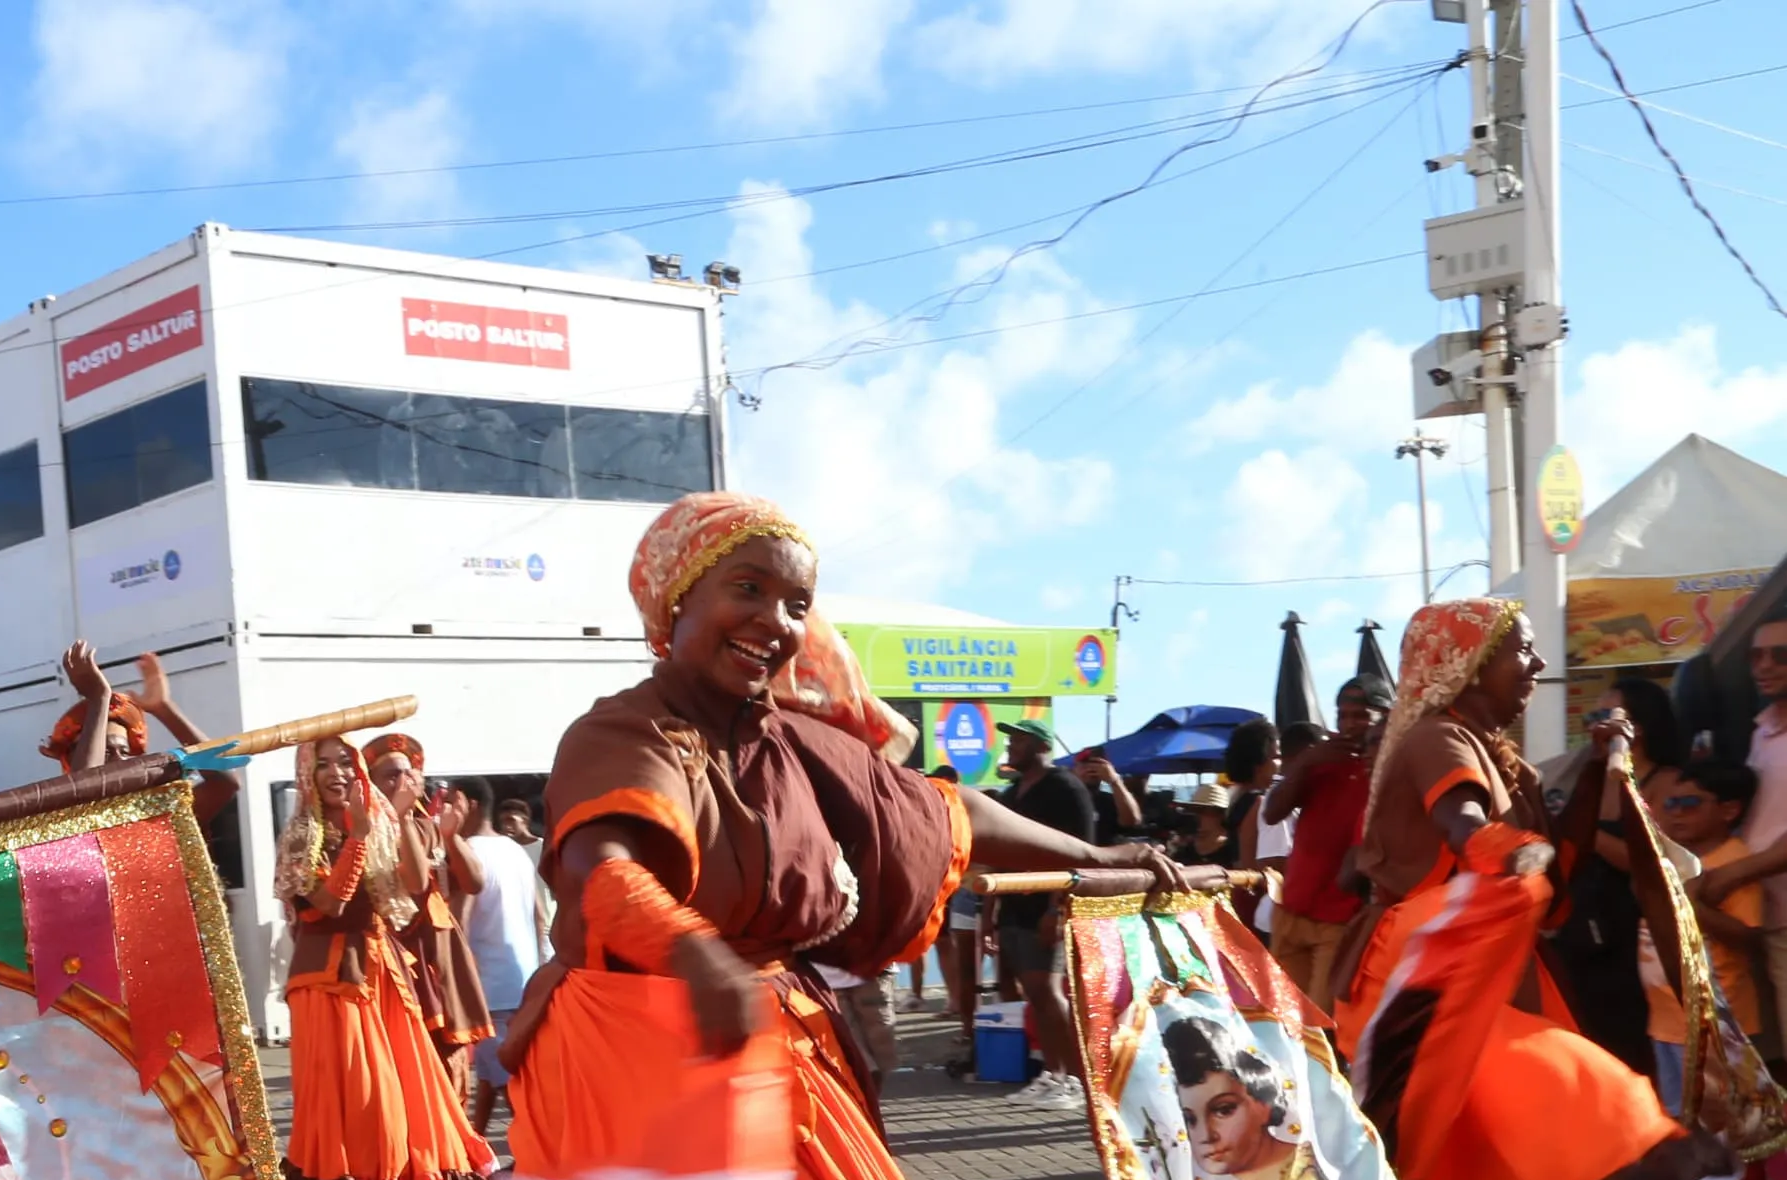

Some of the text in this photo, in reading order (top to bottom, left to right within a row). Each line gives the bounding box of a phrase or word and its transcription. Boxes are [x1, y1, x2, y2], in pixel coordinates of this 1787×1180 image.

[66, 309, 197, 379] POSTO SALTUR
[408, 317, 565, 351] POSTO SALTUR
[902, 635, 1019, 657] VIGILÂNCIA
[907, 658, 1016, 678] SANITÁRIA
